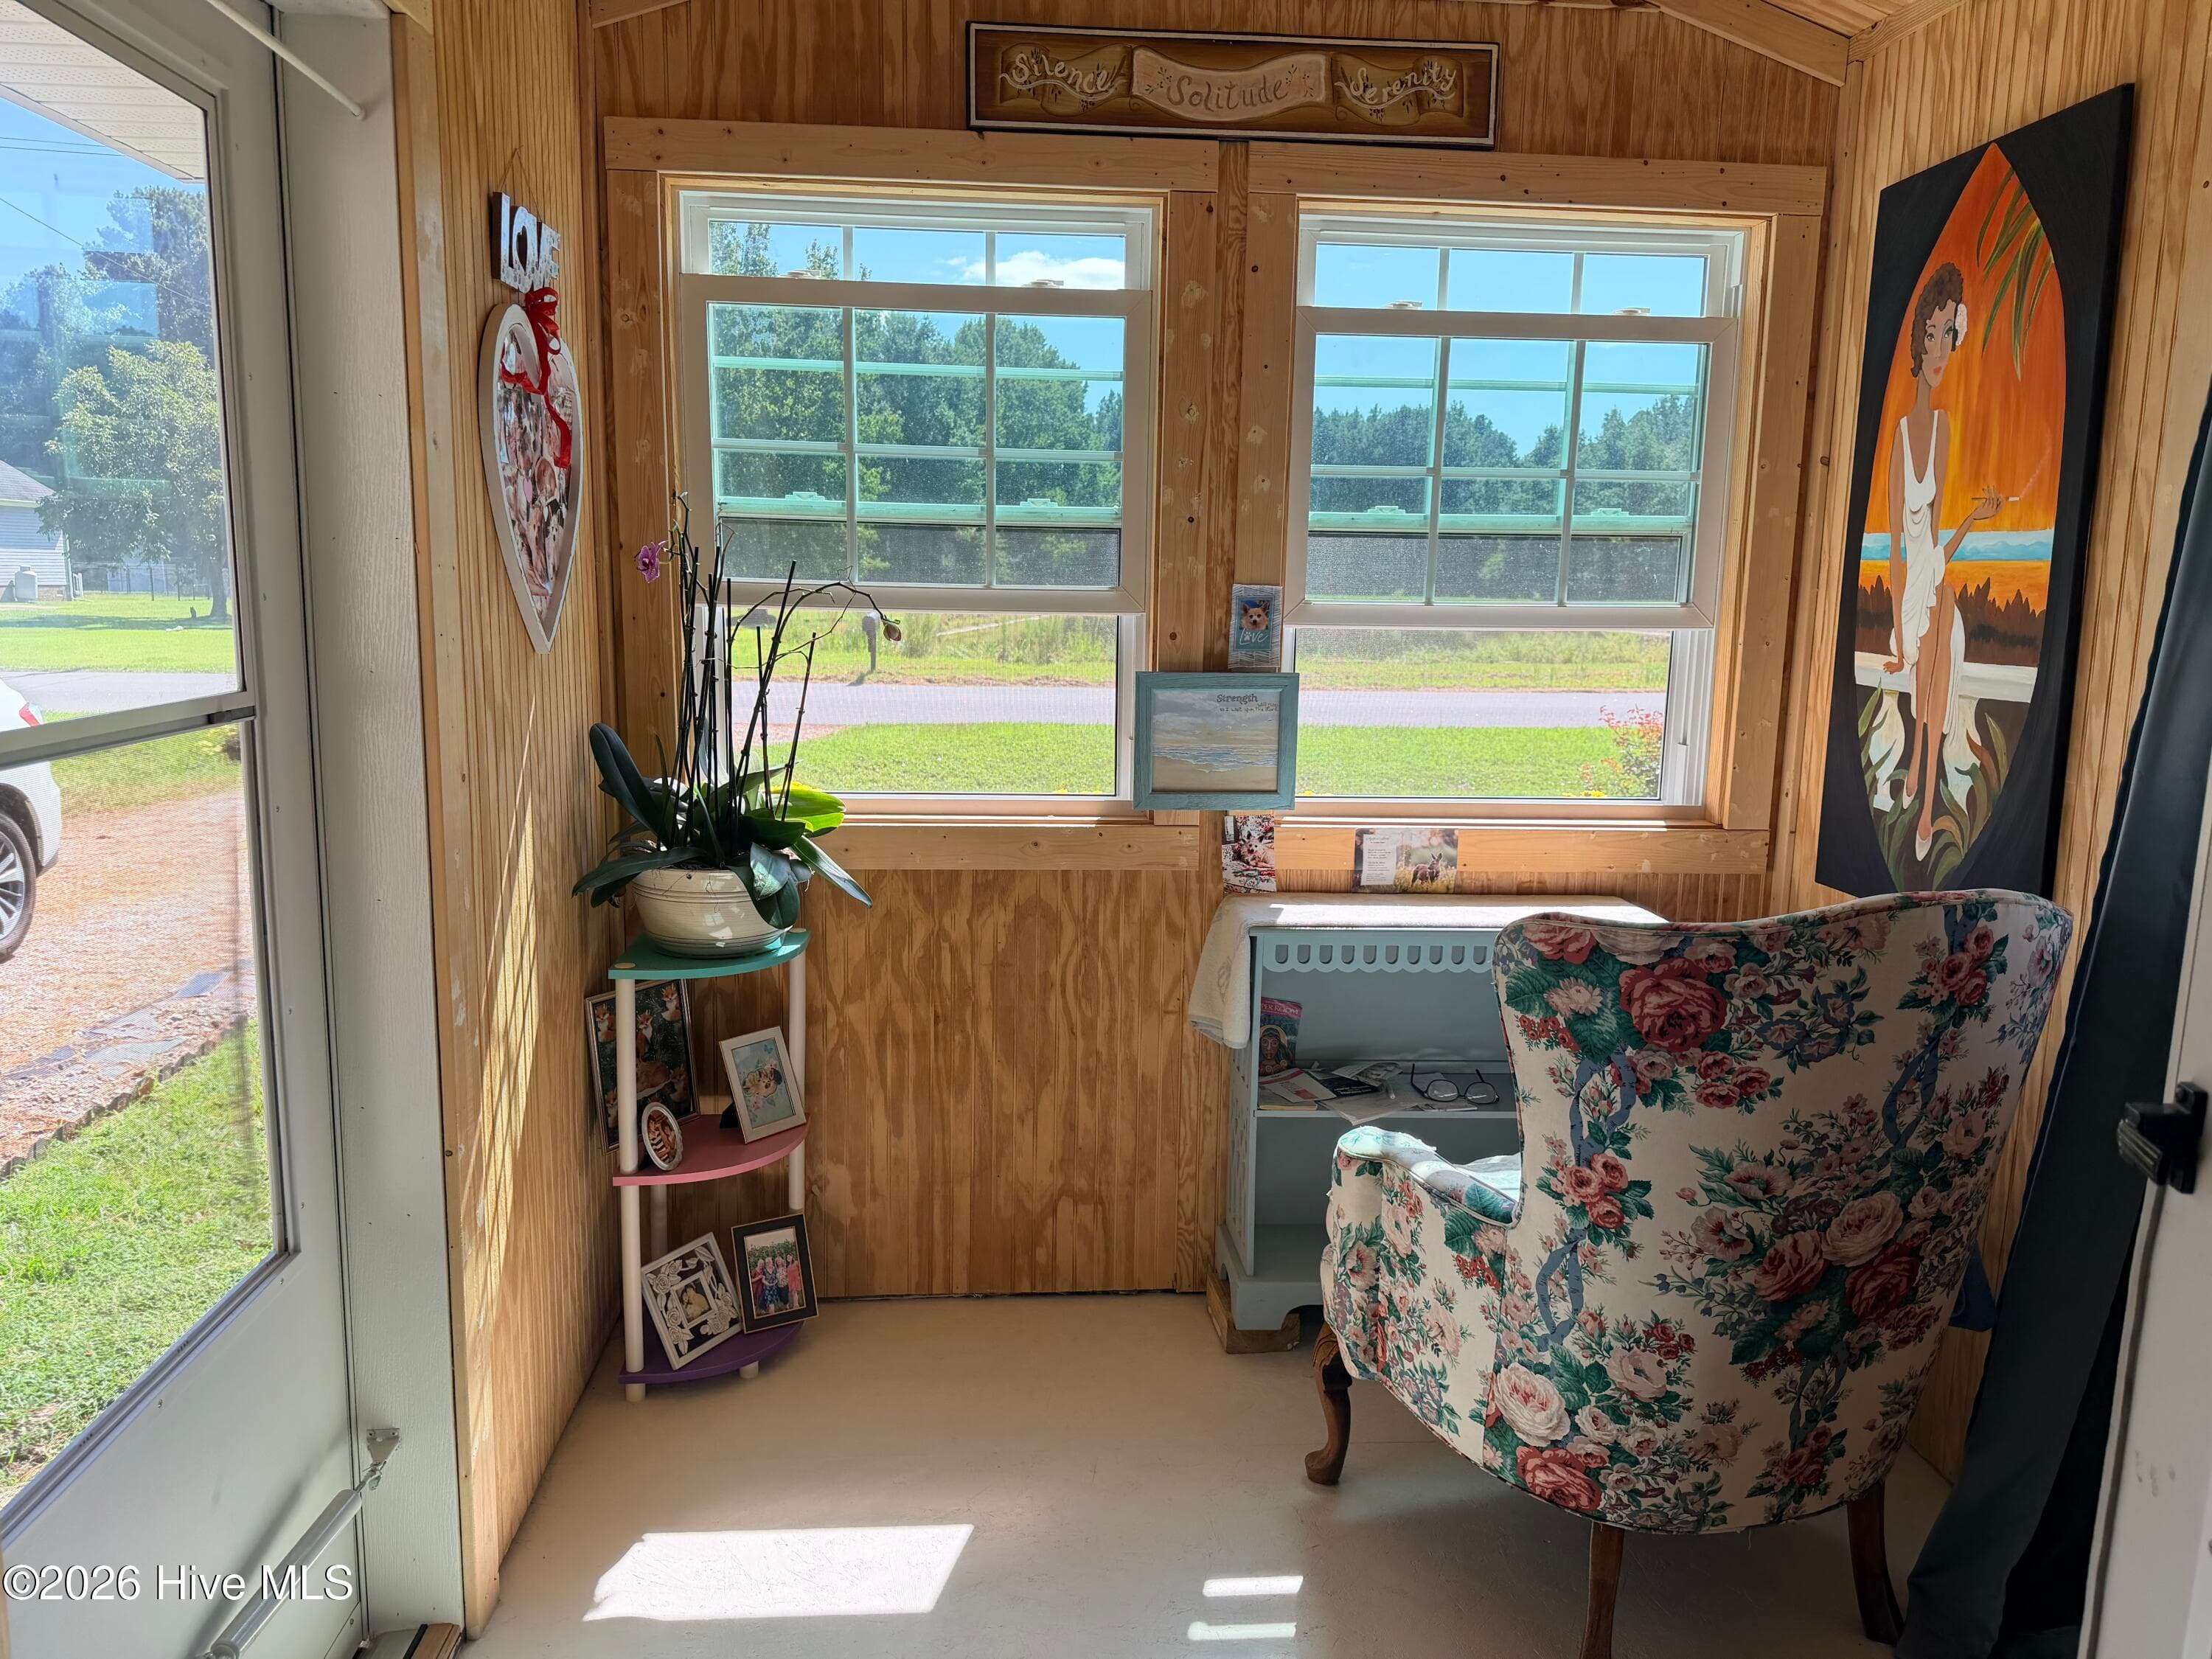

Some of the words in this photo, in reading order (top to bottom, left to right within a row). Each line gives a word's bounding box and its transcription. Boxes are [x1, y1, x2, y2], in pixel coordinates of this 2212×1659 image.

[1012, 53, 1113, 92] Silence
[1166, 74, 1289, 112] Solitude
[1350, 62, 1456, 104] Serenity
[1217, 694, 1258, 704] Strength
